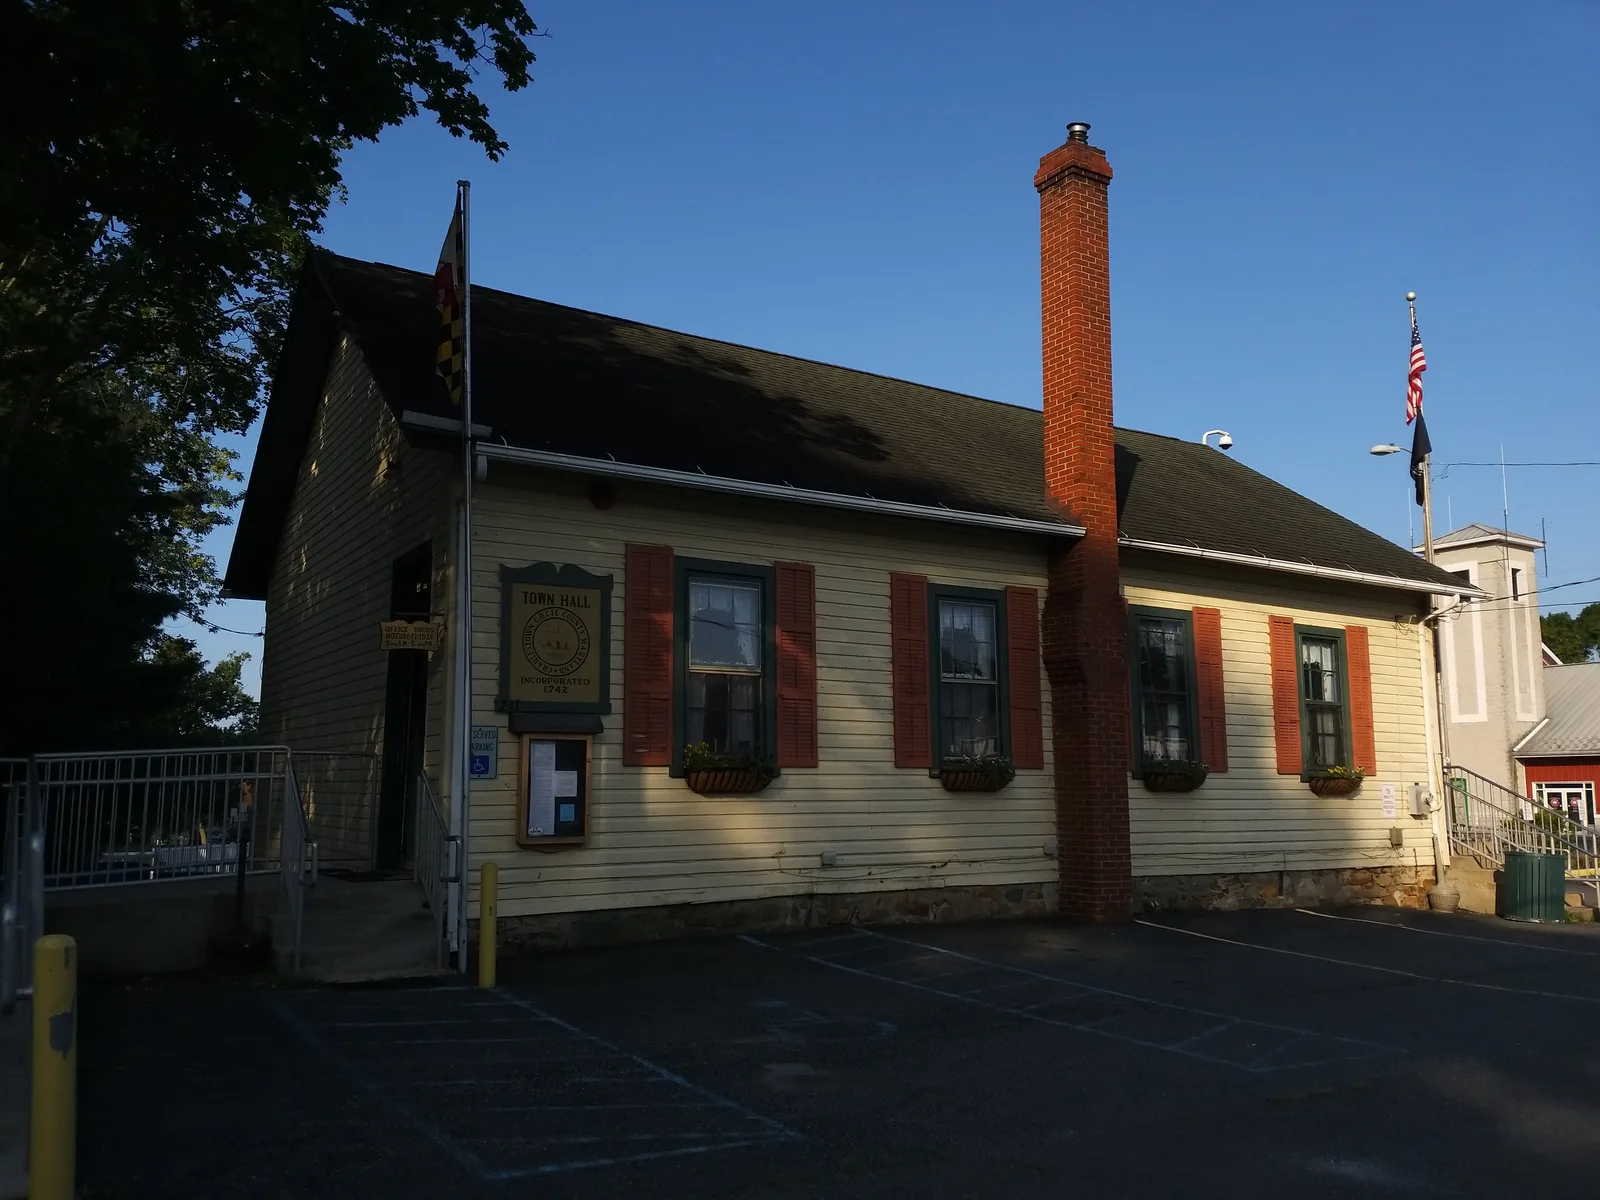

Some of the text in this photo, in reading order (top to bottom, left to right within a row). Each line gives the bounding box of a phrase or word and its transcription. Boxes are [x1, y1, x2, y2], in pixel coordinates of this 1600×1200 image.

[522, 591, 591, 608] TOWN HALL
[562, 611, 586, 634] COUNTY
[559, 638, 588, 674] MARYLAND
[520, 676, 590, 685] INCORPORATED
[472, 730, 496, 739] SERVED
